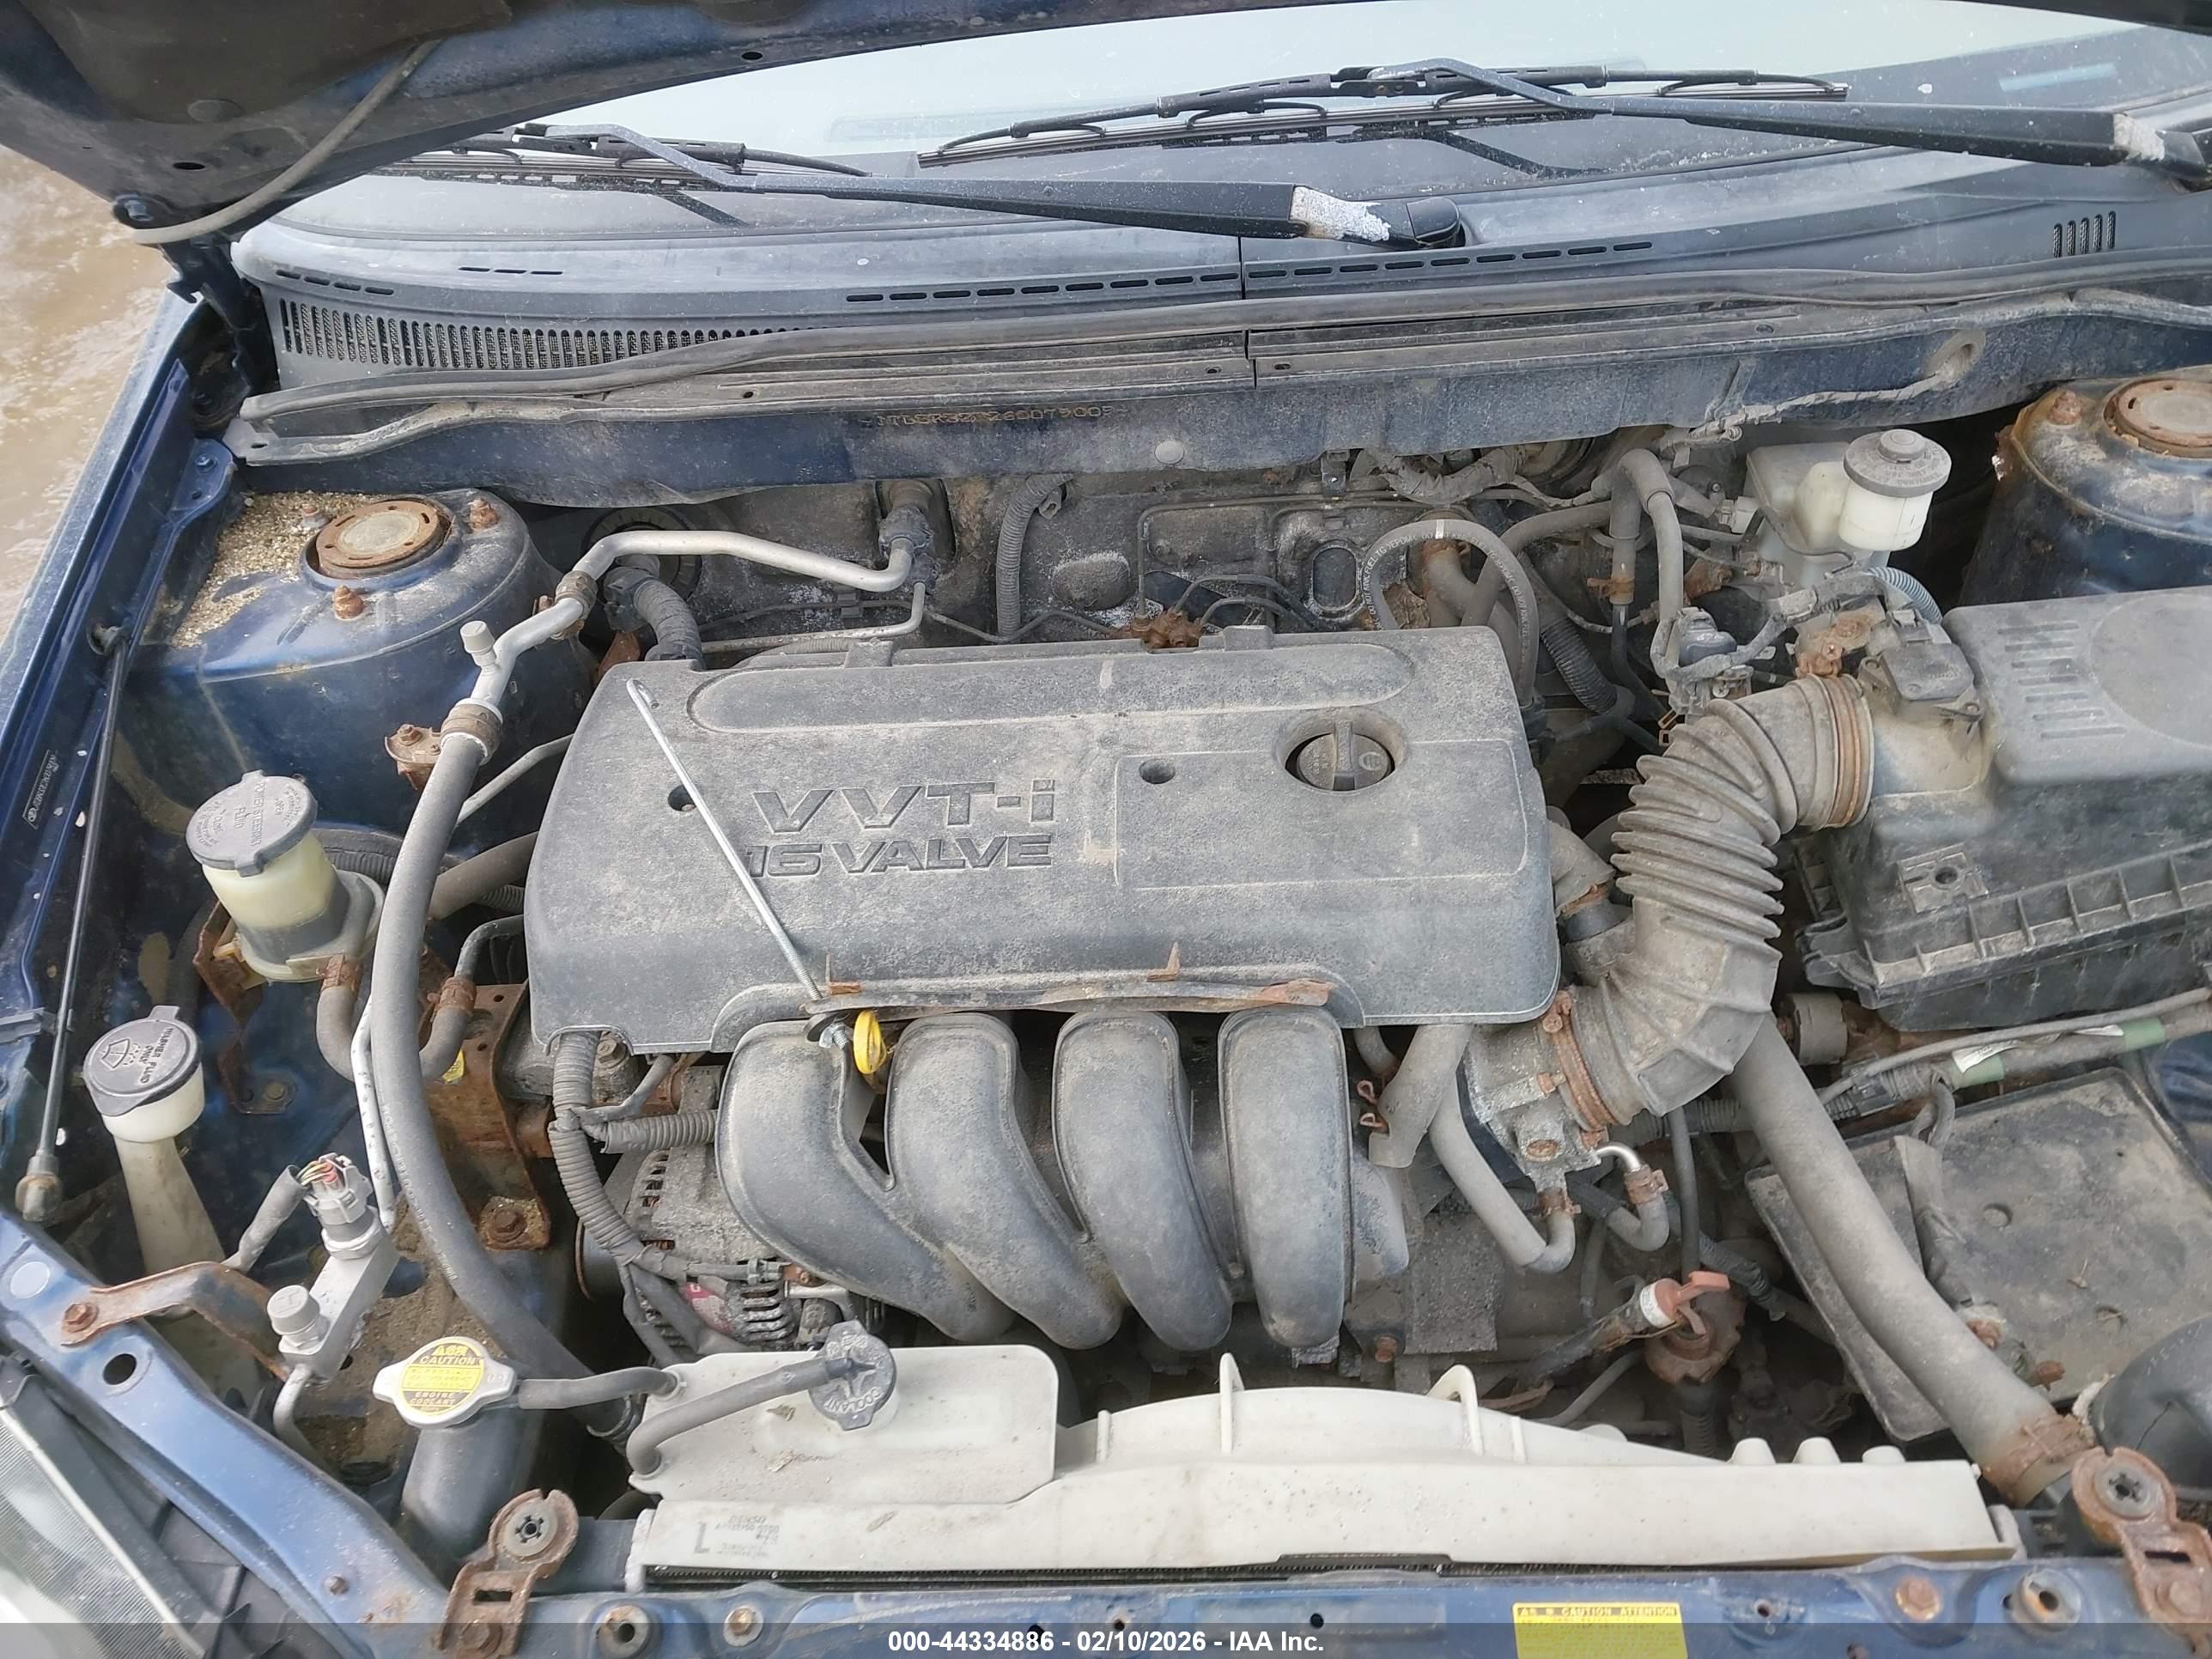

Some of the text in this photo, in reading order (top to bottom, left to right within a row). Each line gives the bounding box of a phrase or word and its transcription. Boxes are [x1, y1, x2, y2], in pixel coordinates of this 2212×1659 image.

[253, 781, 268, 810] POWER
[751, 779, 1056, 835] VVT-i
[830, 834, 1052, 874] VALVE
[139, 1028, 173, 1084] WASHER FLUID
[419, 1355, 477, 1366] CAUTION
[1561, 1607, 1612, 1616] CAUTION
